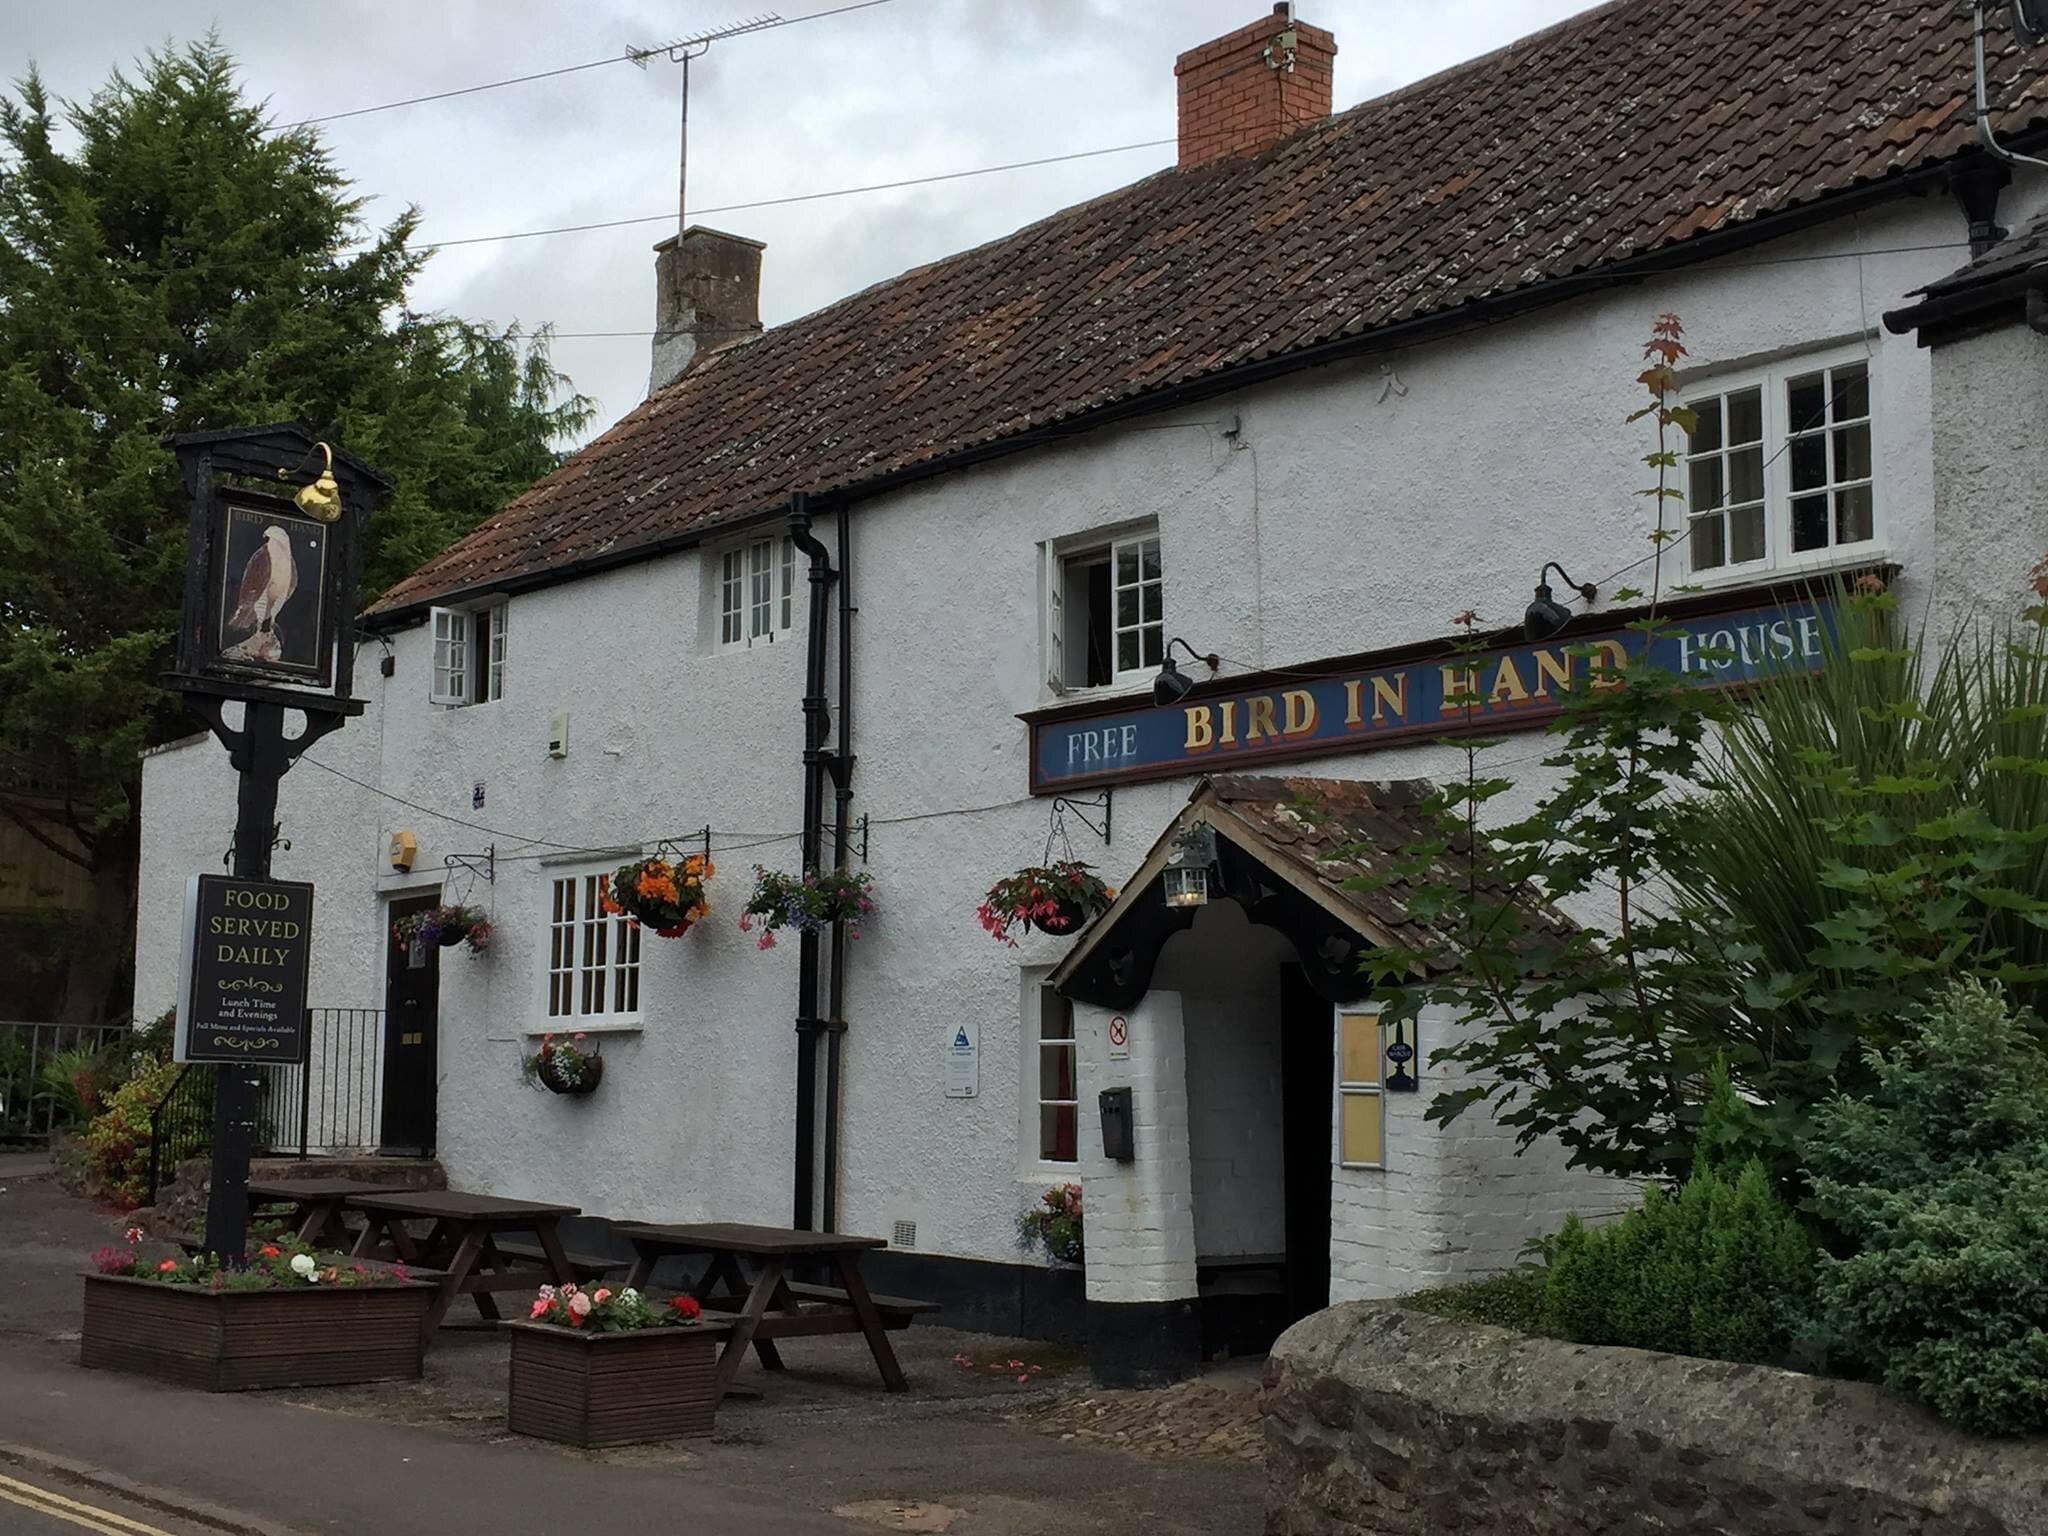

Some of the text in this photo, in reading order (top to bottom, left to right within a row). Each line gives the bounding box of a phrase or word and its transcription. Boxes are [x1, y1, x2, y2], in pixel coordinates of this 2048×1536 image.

[1067, 616, 1821, 765] FREE BIRD IN HAND HOUSE
[225, 890, 289, 911] FOOD
[211, 916, 300, 939] SERVED
[217, 945, 290, 966] DAILY
[222, 997, 277, 1009] Lunch Time
[218, 1008, 278, 1022] and Evenings
